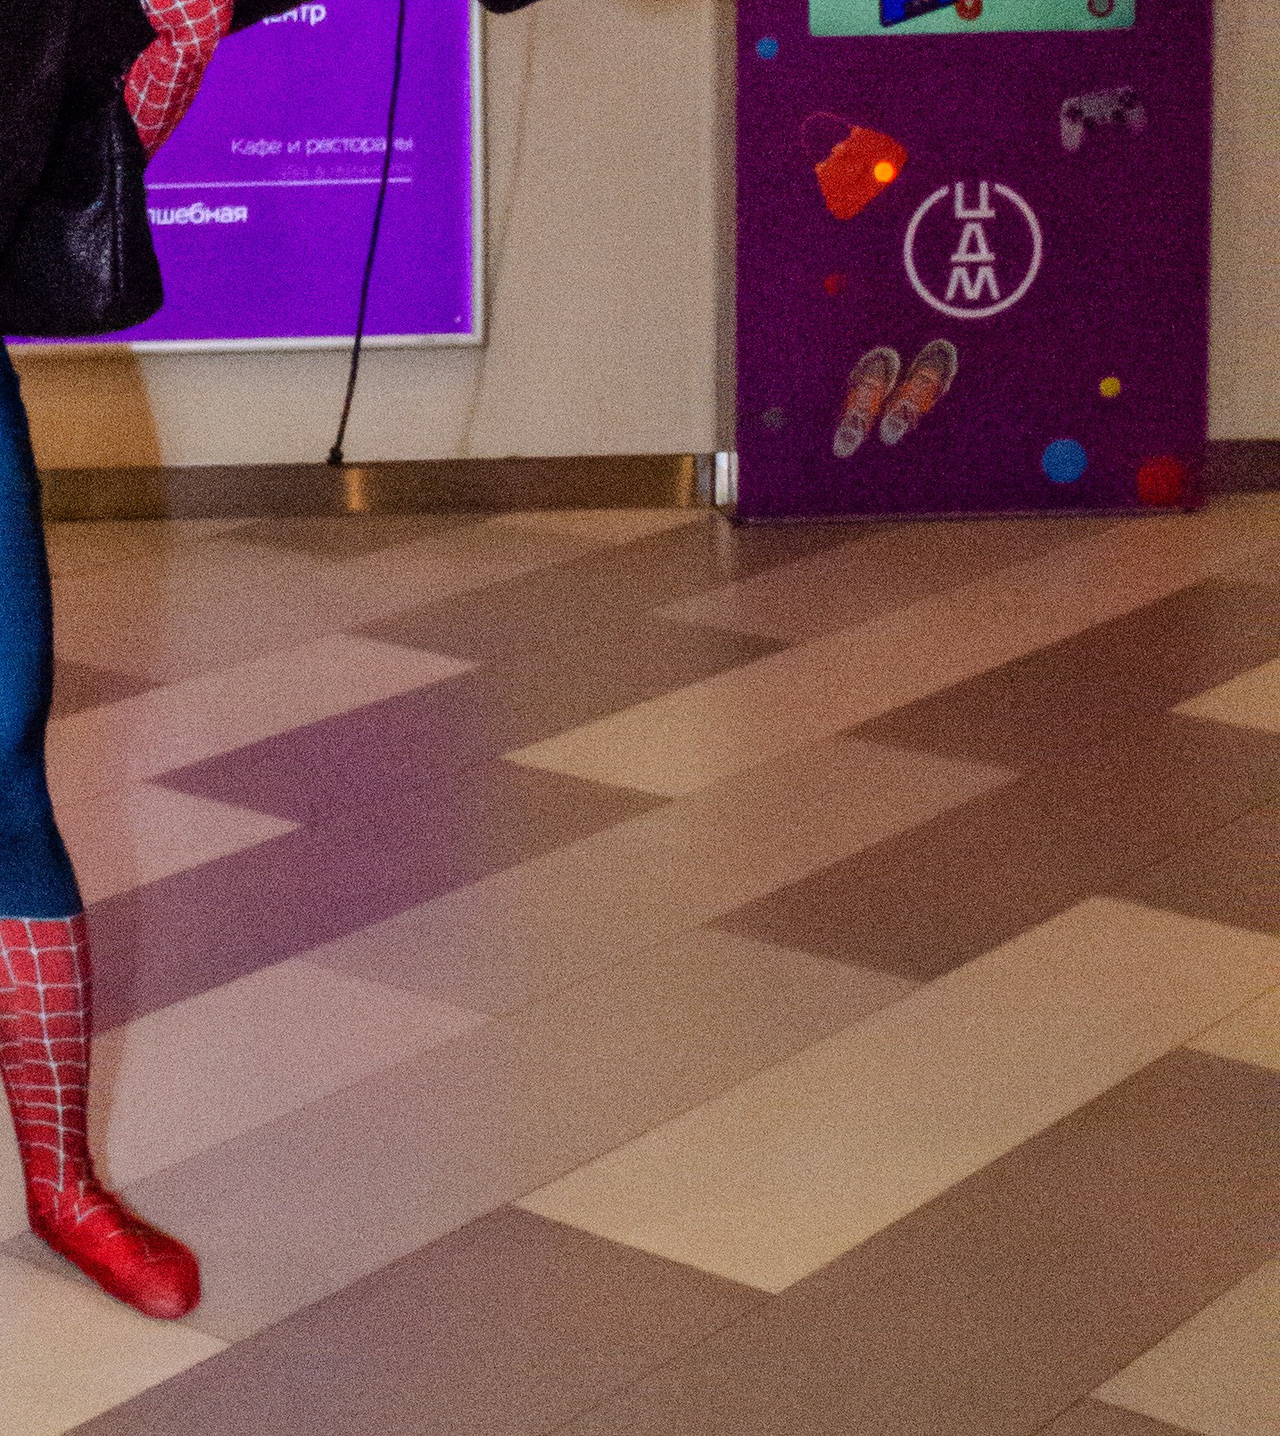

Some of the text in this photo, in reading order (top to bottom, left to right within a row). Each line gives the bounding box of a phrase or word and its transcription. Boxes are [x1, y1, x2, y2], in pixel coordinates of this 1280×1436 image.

[231, 136, 413, 157] Кафе и рестораы
